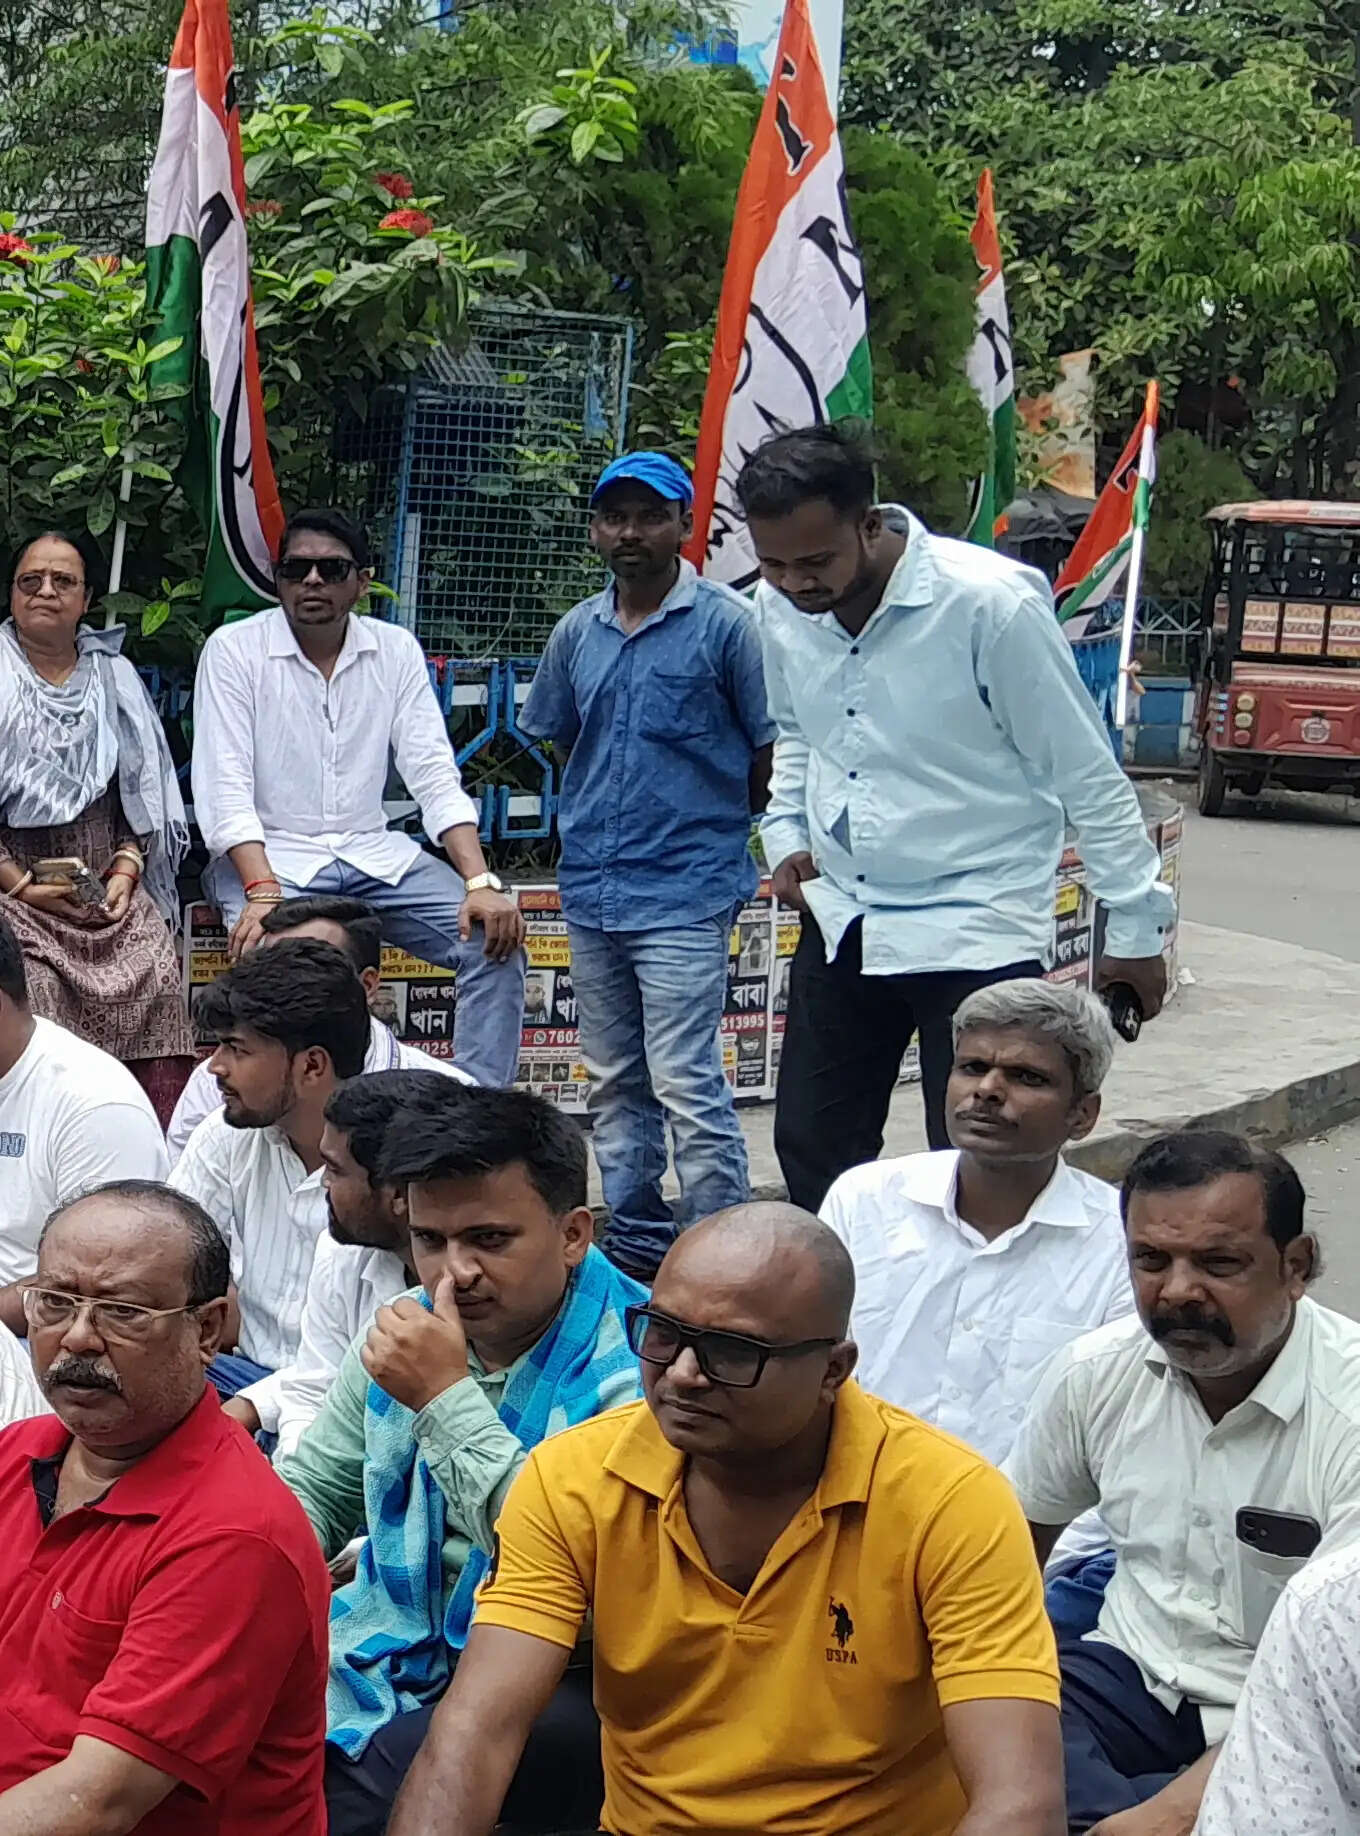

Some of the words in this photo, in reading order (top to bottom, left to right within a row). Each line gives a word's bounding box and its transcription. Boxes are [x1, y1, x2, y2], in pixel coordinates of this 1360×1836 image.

[732, 982, 766, 1009] বাবা
[411, 1009, 447, 1034] খান
[825, 1647, 858, 1665] USPA
